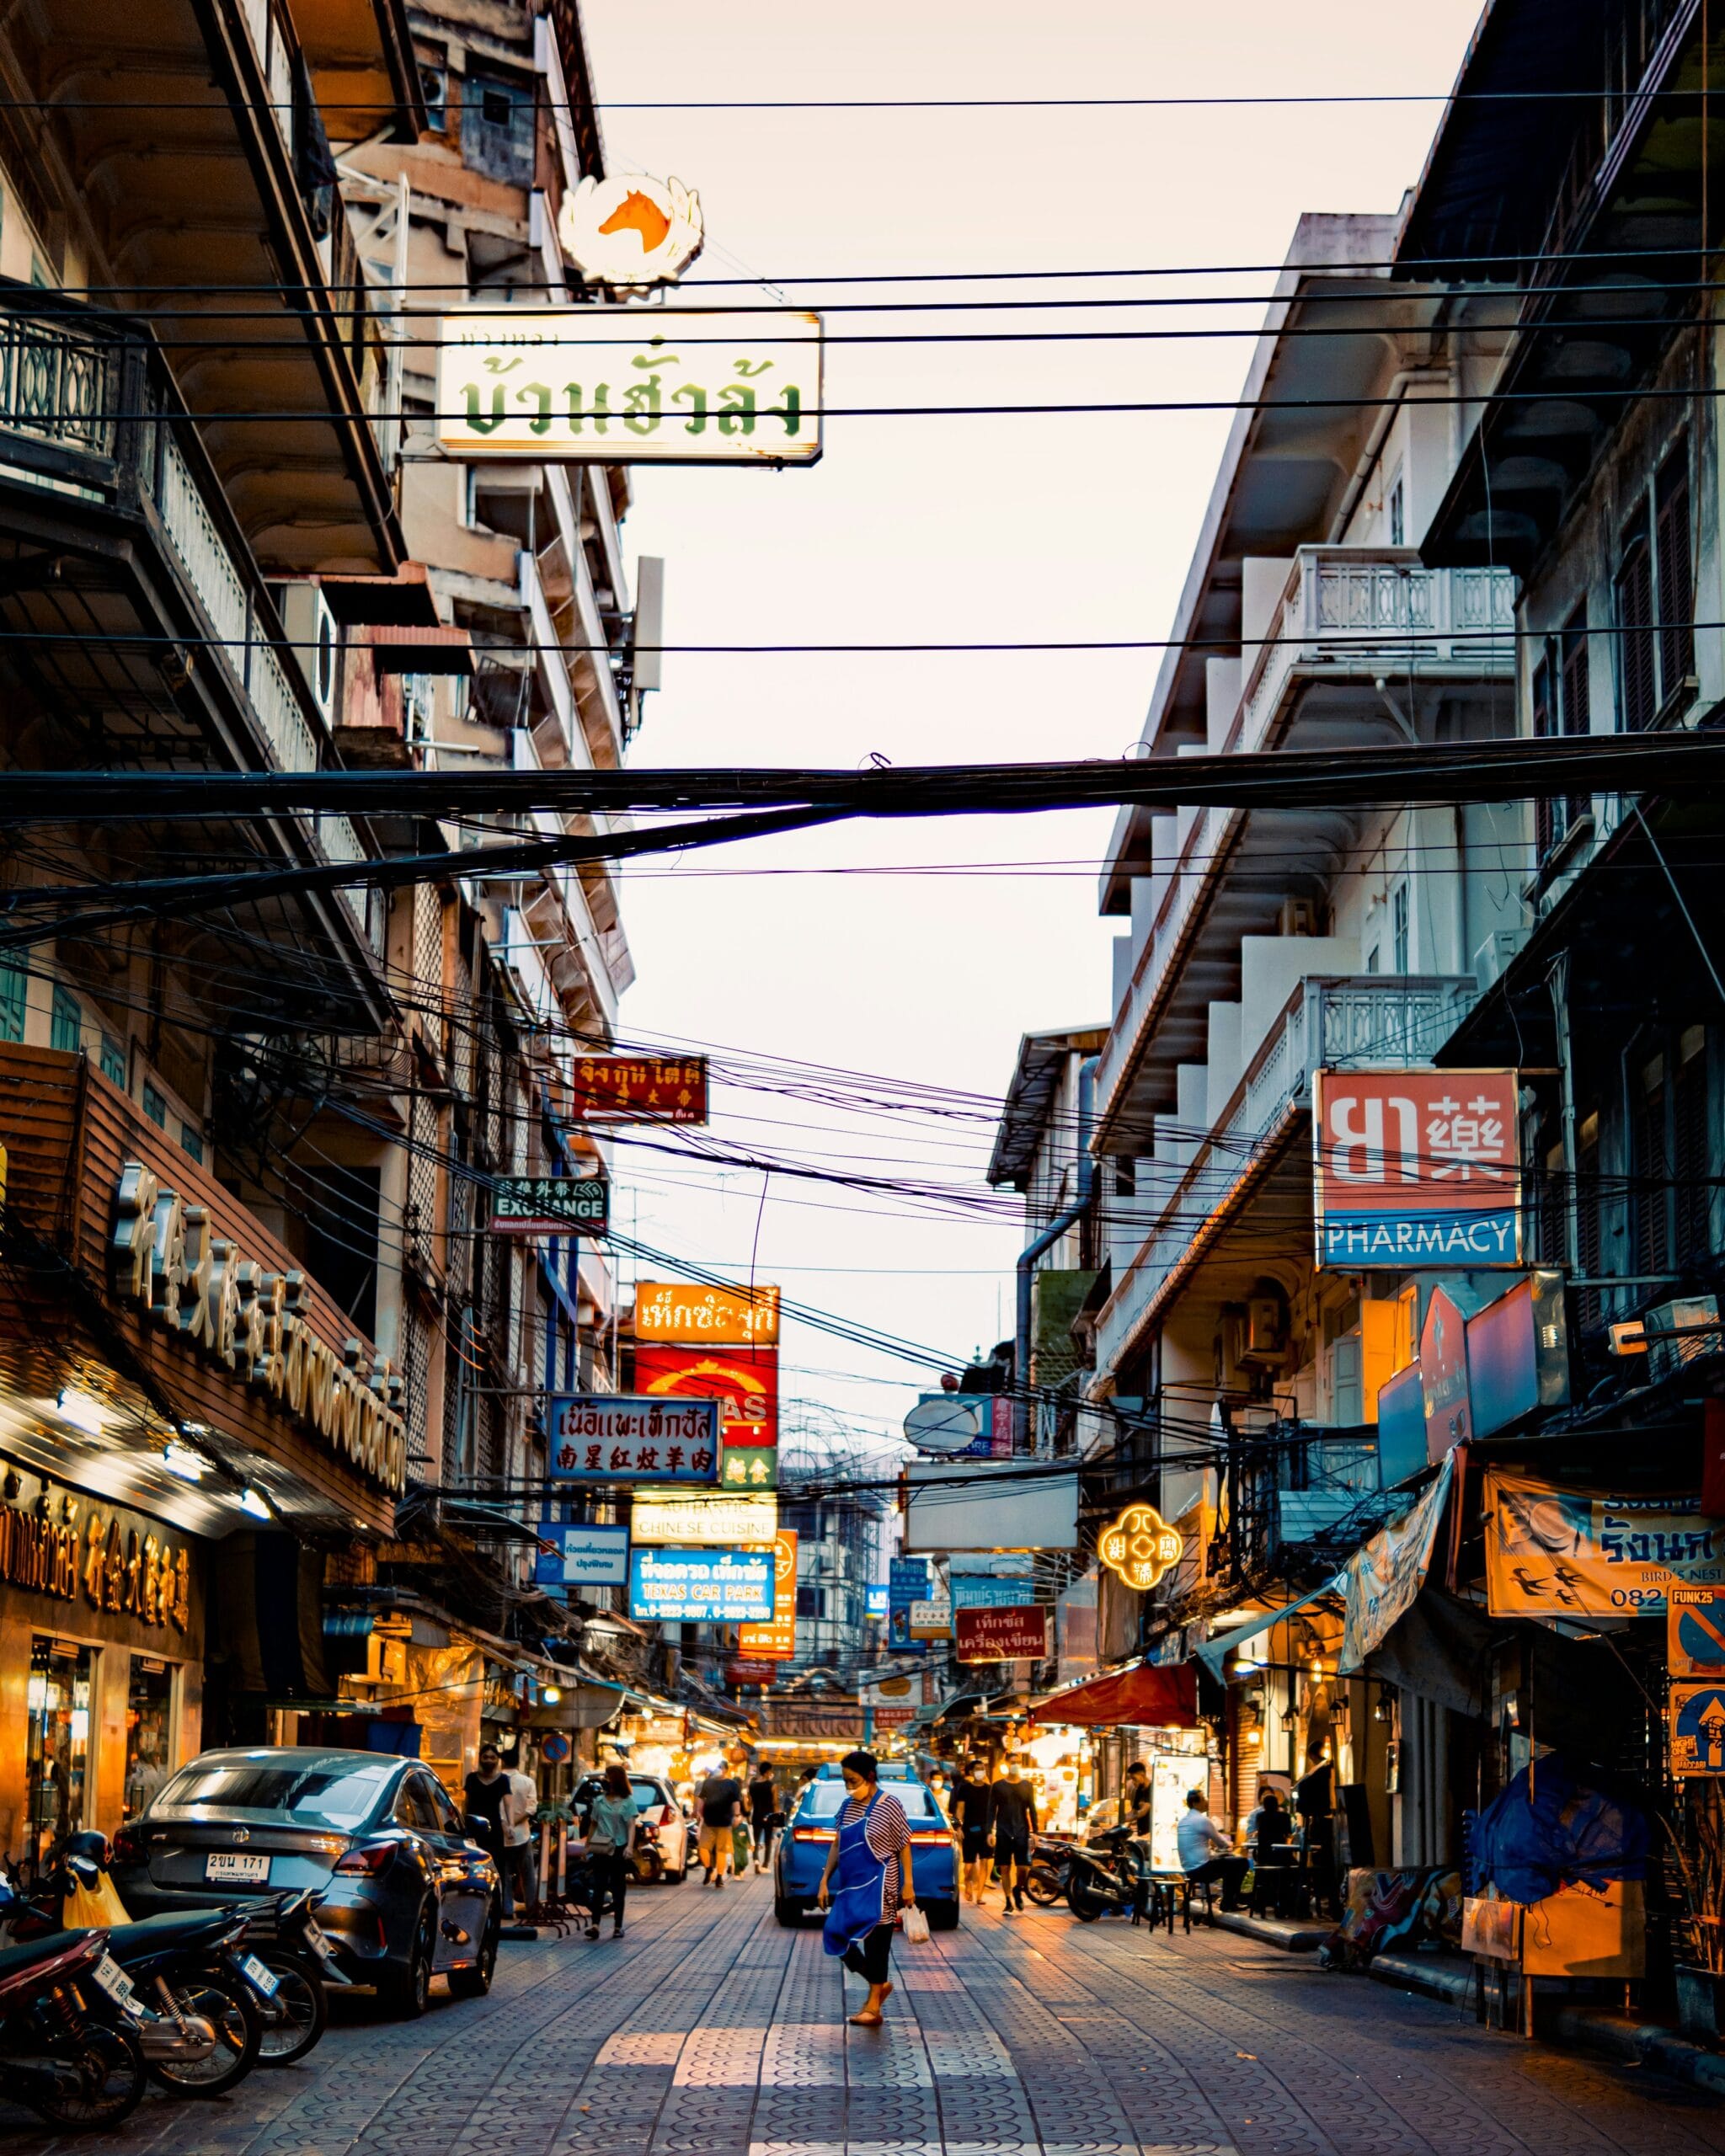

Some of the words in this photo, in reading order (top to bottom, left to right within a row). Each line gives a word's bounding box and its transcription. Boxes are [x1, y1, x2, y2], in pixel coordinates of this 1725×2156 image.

[1330, 1097, 1418, 1184] ยา
[1426, 1096, 1503, 1180] 藥
[1328, 1220, 1511, 1253] PHARMACY
[724, 1395, 767, 1421] AS
[639, 1521, 704, 1534] CHINESE
[710, 1521, 770, 1534] CUISINE
[1601, 1516, 1714, 1563] รังนก
[1690, 1569, 1722, 1581] NEST
[644, 1584, 686, 1600] TEXAS
[692, 1585, 721, 1600] CAR
[725, 1585, 764, 1601] PARK
[1674, 1591, 1713, 1604] FUNK25
[976, 1612, 1024, 1629] เท็กซัส
[959, 1631, 1044, 1649] เครื่องเขียน
[243, 1858, 263, 1869] 171
